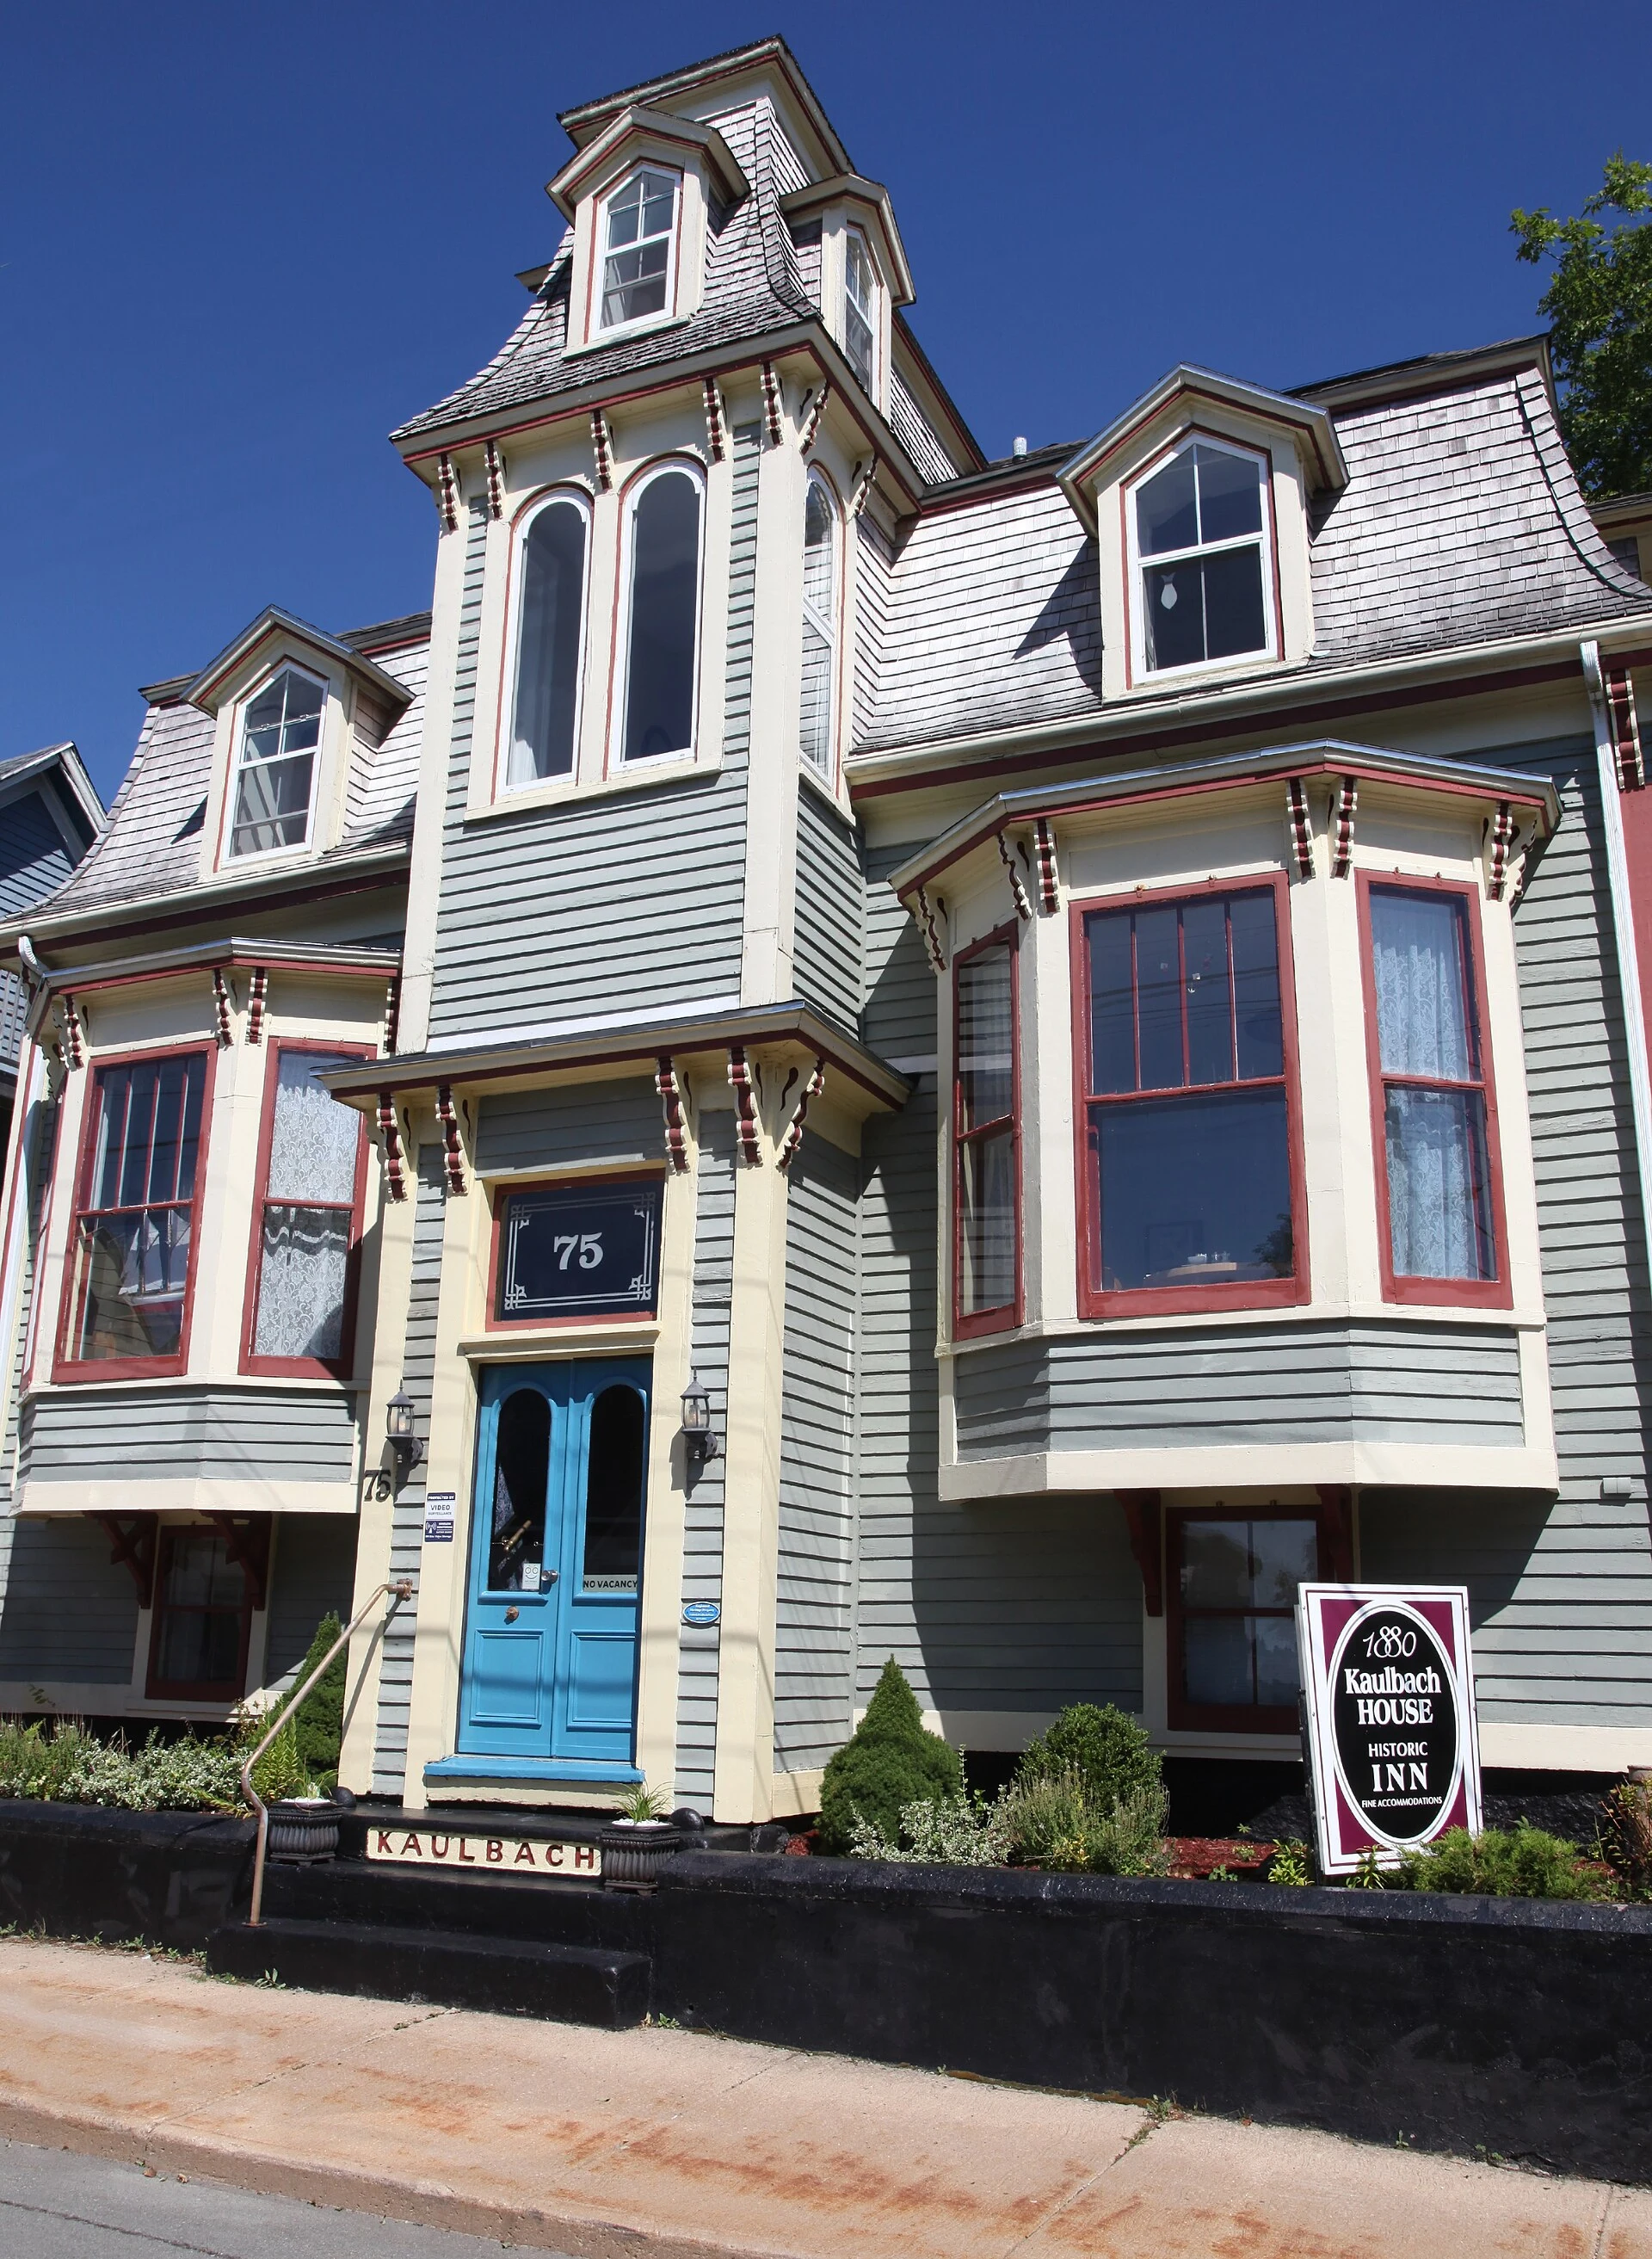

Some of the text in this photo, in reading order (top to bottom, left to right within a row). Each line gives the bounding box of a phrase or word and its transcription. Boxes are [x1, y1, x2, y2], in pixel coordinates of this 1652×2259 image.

[553, 1231, 603, 1270] 75
[363, 1469, 391, 1503] 75
[583, 1580, 638, 1589] NO VACANCY
[1362, 1626, 1417, 1658] 1880
[1343, 1665, 1442, 1696] Kaulbach
[1357, 1698, 1433, 1725] HOUSE
[1368, 1741, 1428, 1758] HISTORIC
[1372, 1762, 1428, 1793] INN
[1361, 1796, 1443, 1808] FINE ACCOMMODATIONS
[377, 1830, 595, 1869] KAULBACH
